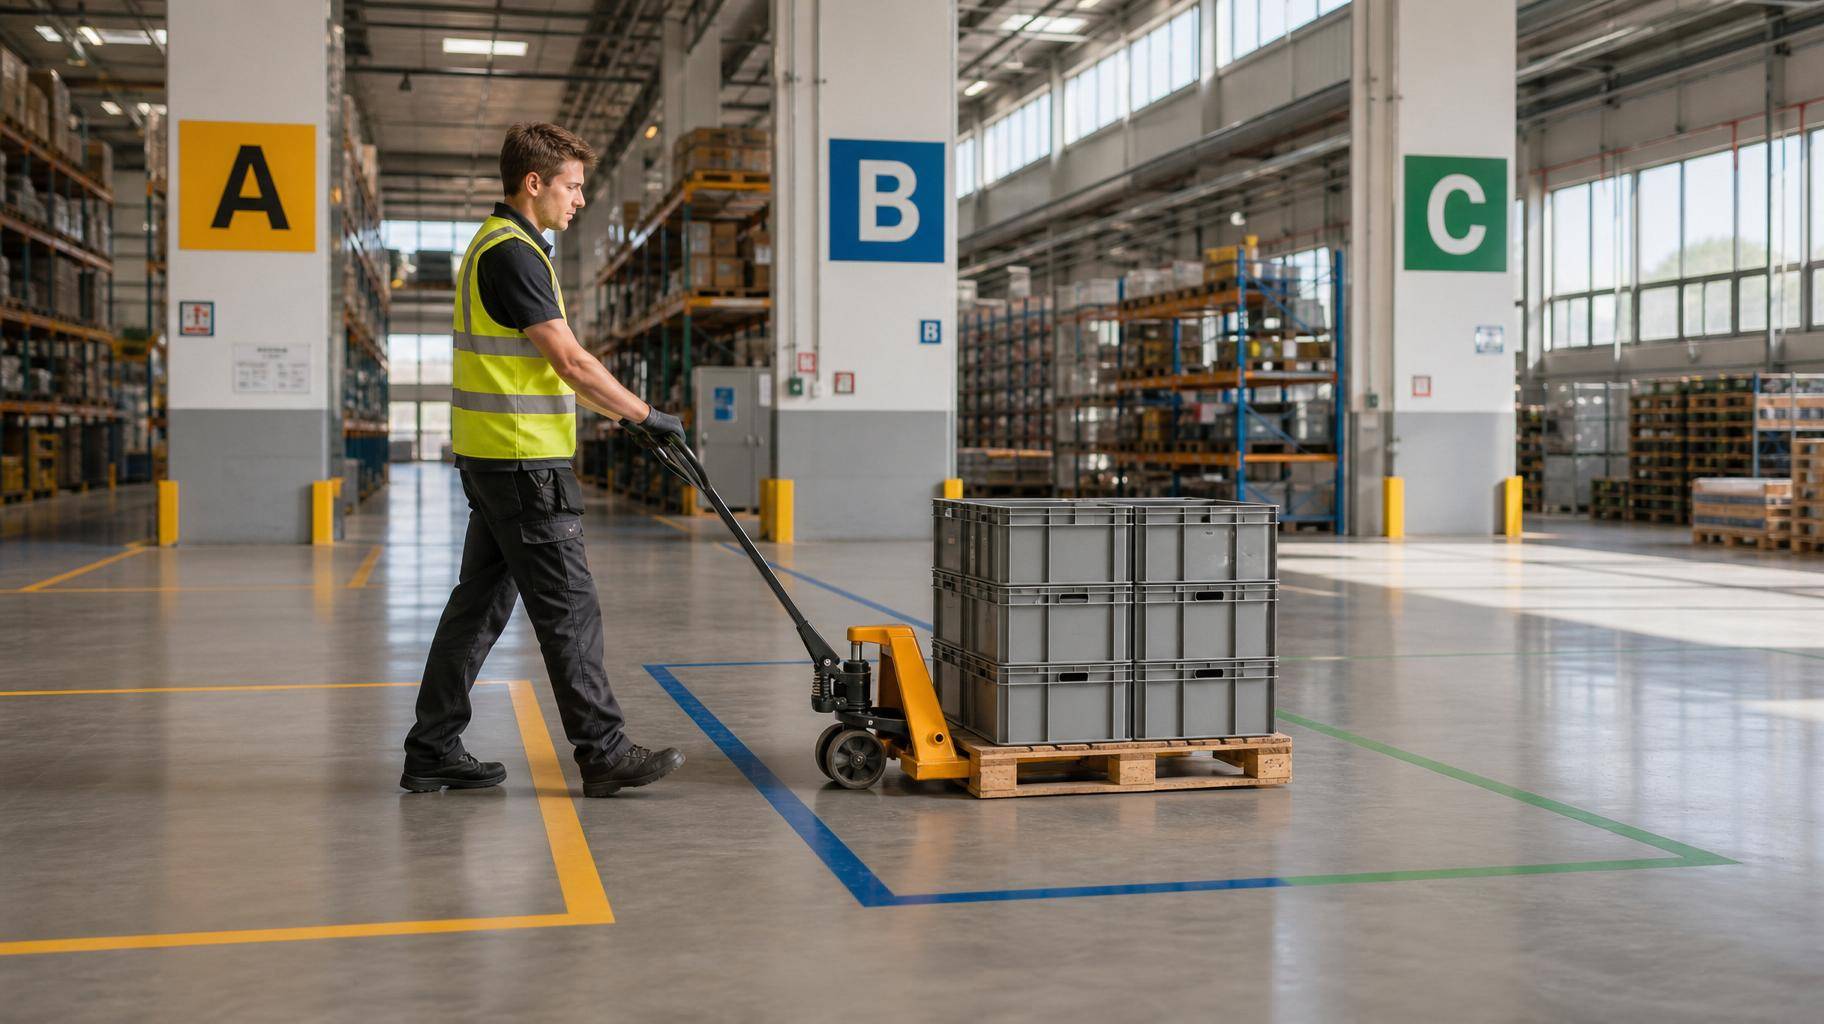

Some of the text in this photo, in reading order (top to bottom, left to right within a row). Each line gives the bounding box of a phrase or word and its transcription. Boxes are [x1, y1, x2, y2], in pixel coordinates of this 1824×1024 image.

[211, 144, 290, 229] A
[858, 160, 920, 242] B
[1427, 173, 1487, 256] C
[924, 322, 938, 340] B
